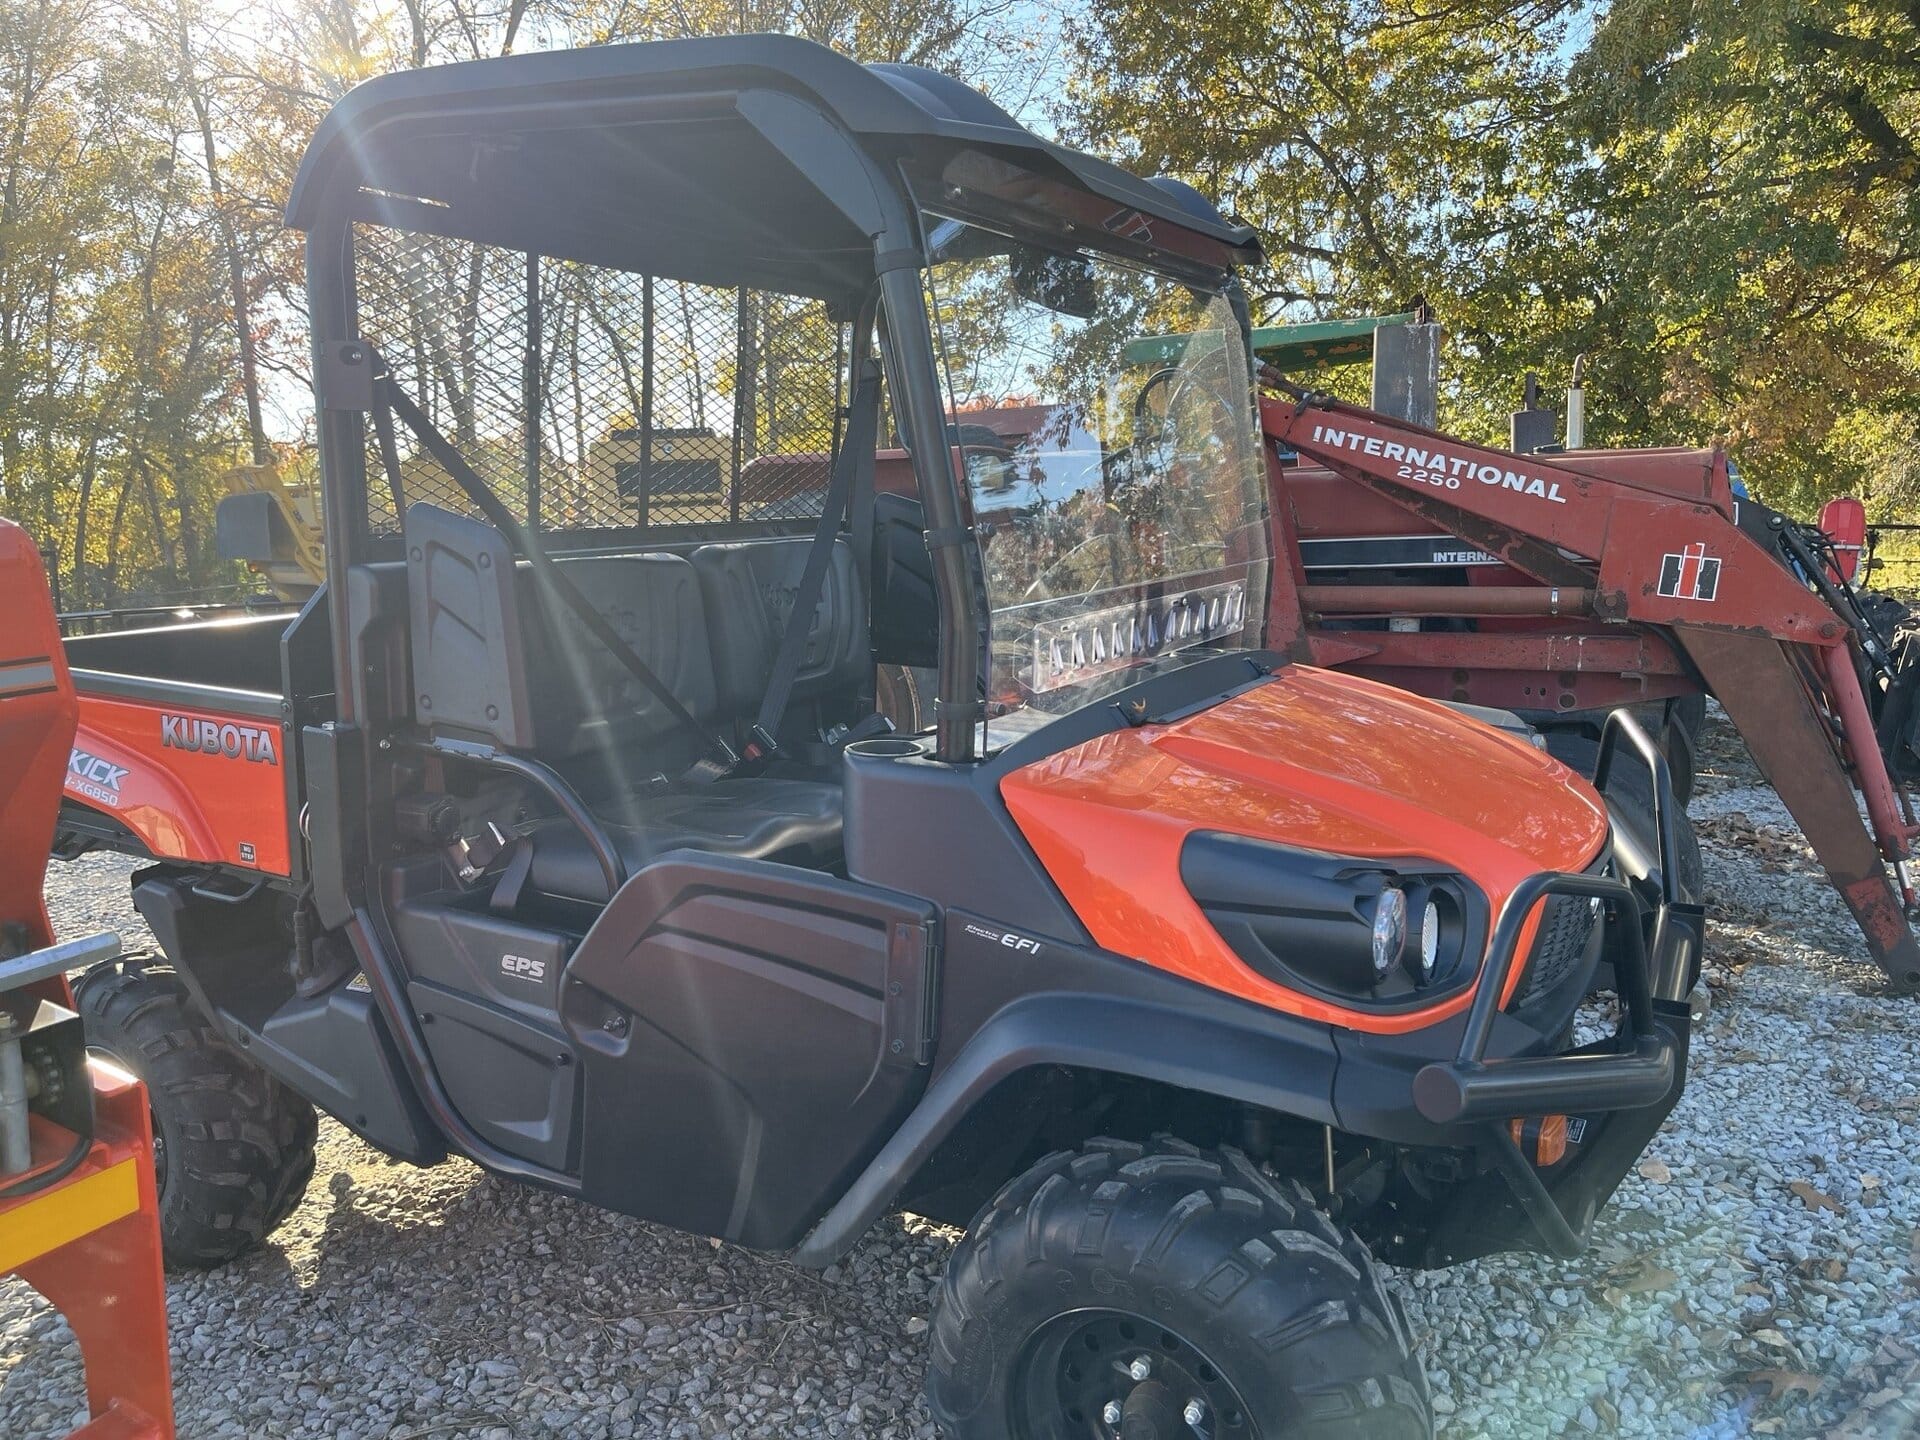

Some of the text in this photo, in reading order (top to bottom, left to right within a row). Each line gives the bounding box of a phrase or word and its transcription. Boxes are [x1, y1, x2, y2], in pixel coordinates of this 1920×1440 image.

[1312, 425, 1567, 504] INTERNATIONAL
[1397, 465, 1460, 490] 2250
[161, 713, 278, 766] KUBOTA
[1001, 933, 1041, 955] EFI
[501, 954, 545, 977] EPS
